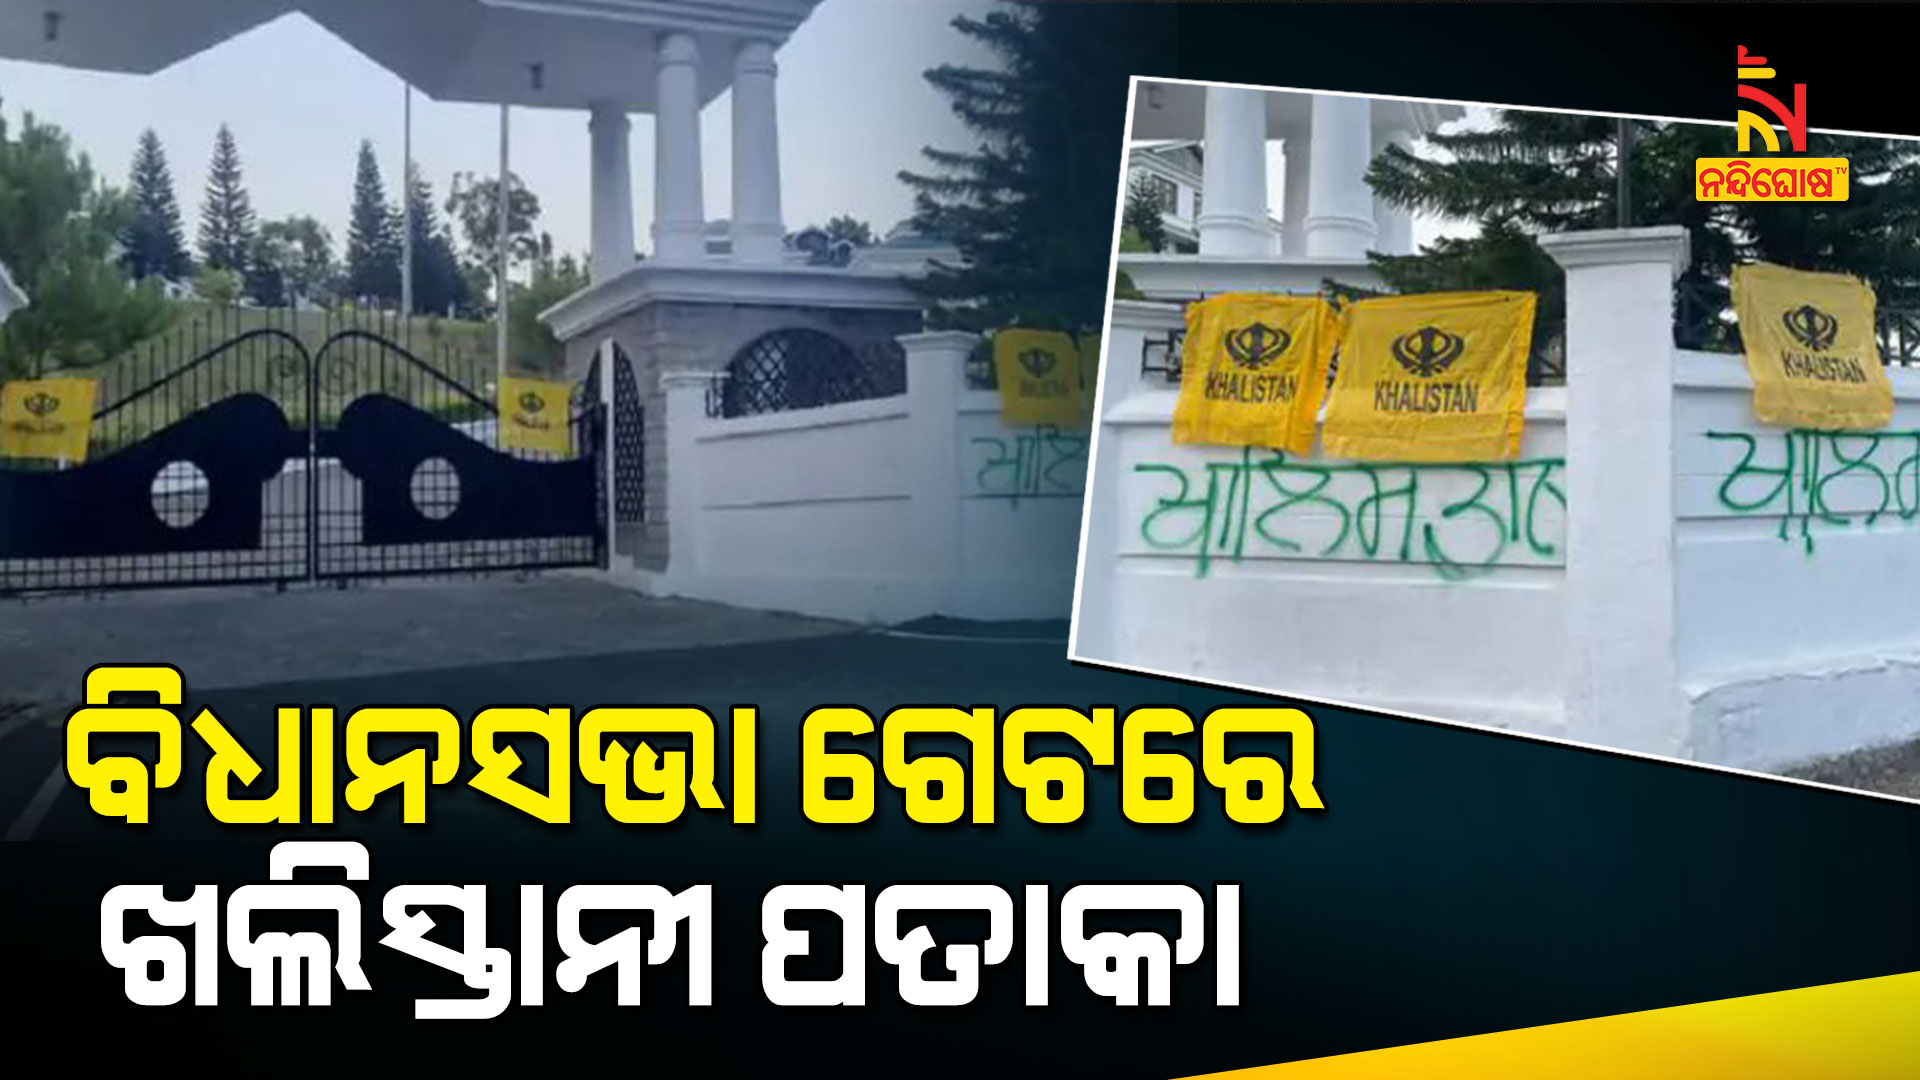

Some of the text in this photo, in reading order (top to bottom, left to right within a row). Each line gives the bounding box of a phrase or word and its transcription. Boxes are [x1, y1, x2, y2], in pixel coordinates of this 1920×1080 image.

[1781, 350, 1866, 382] KHALISTAN
[1205, 371, 1298, 403] KHALISTAN
[1374, 380, 1480, 413] KHALISTAN
